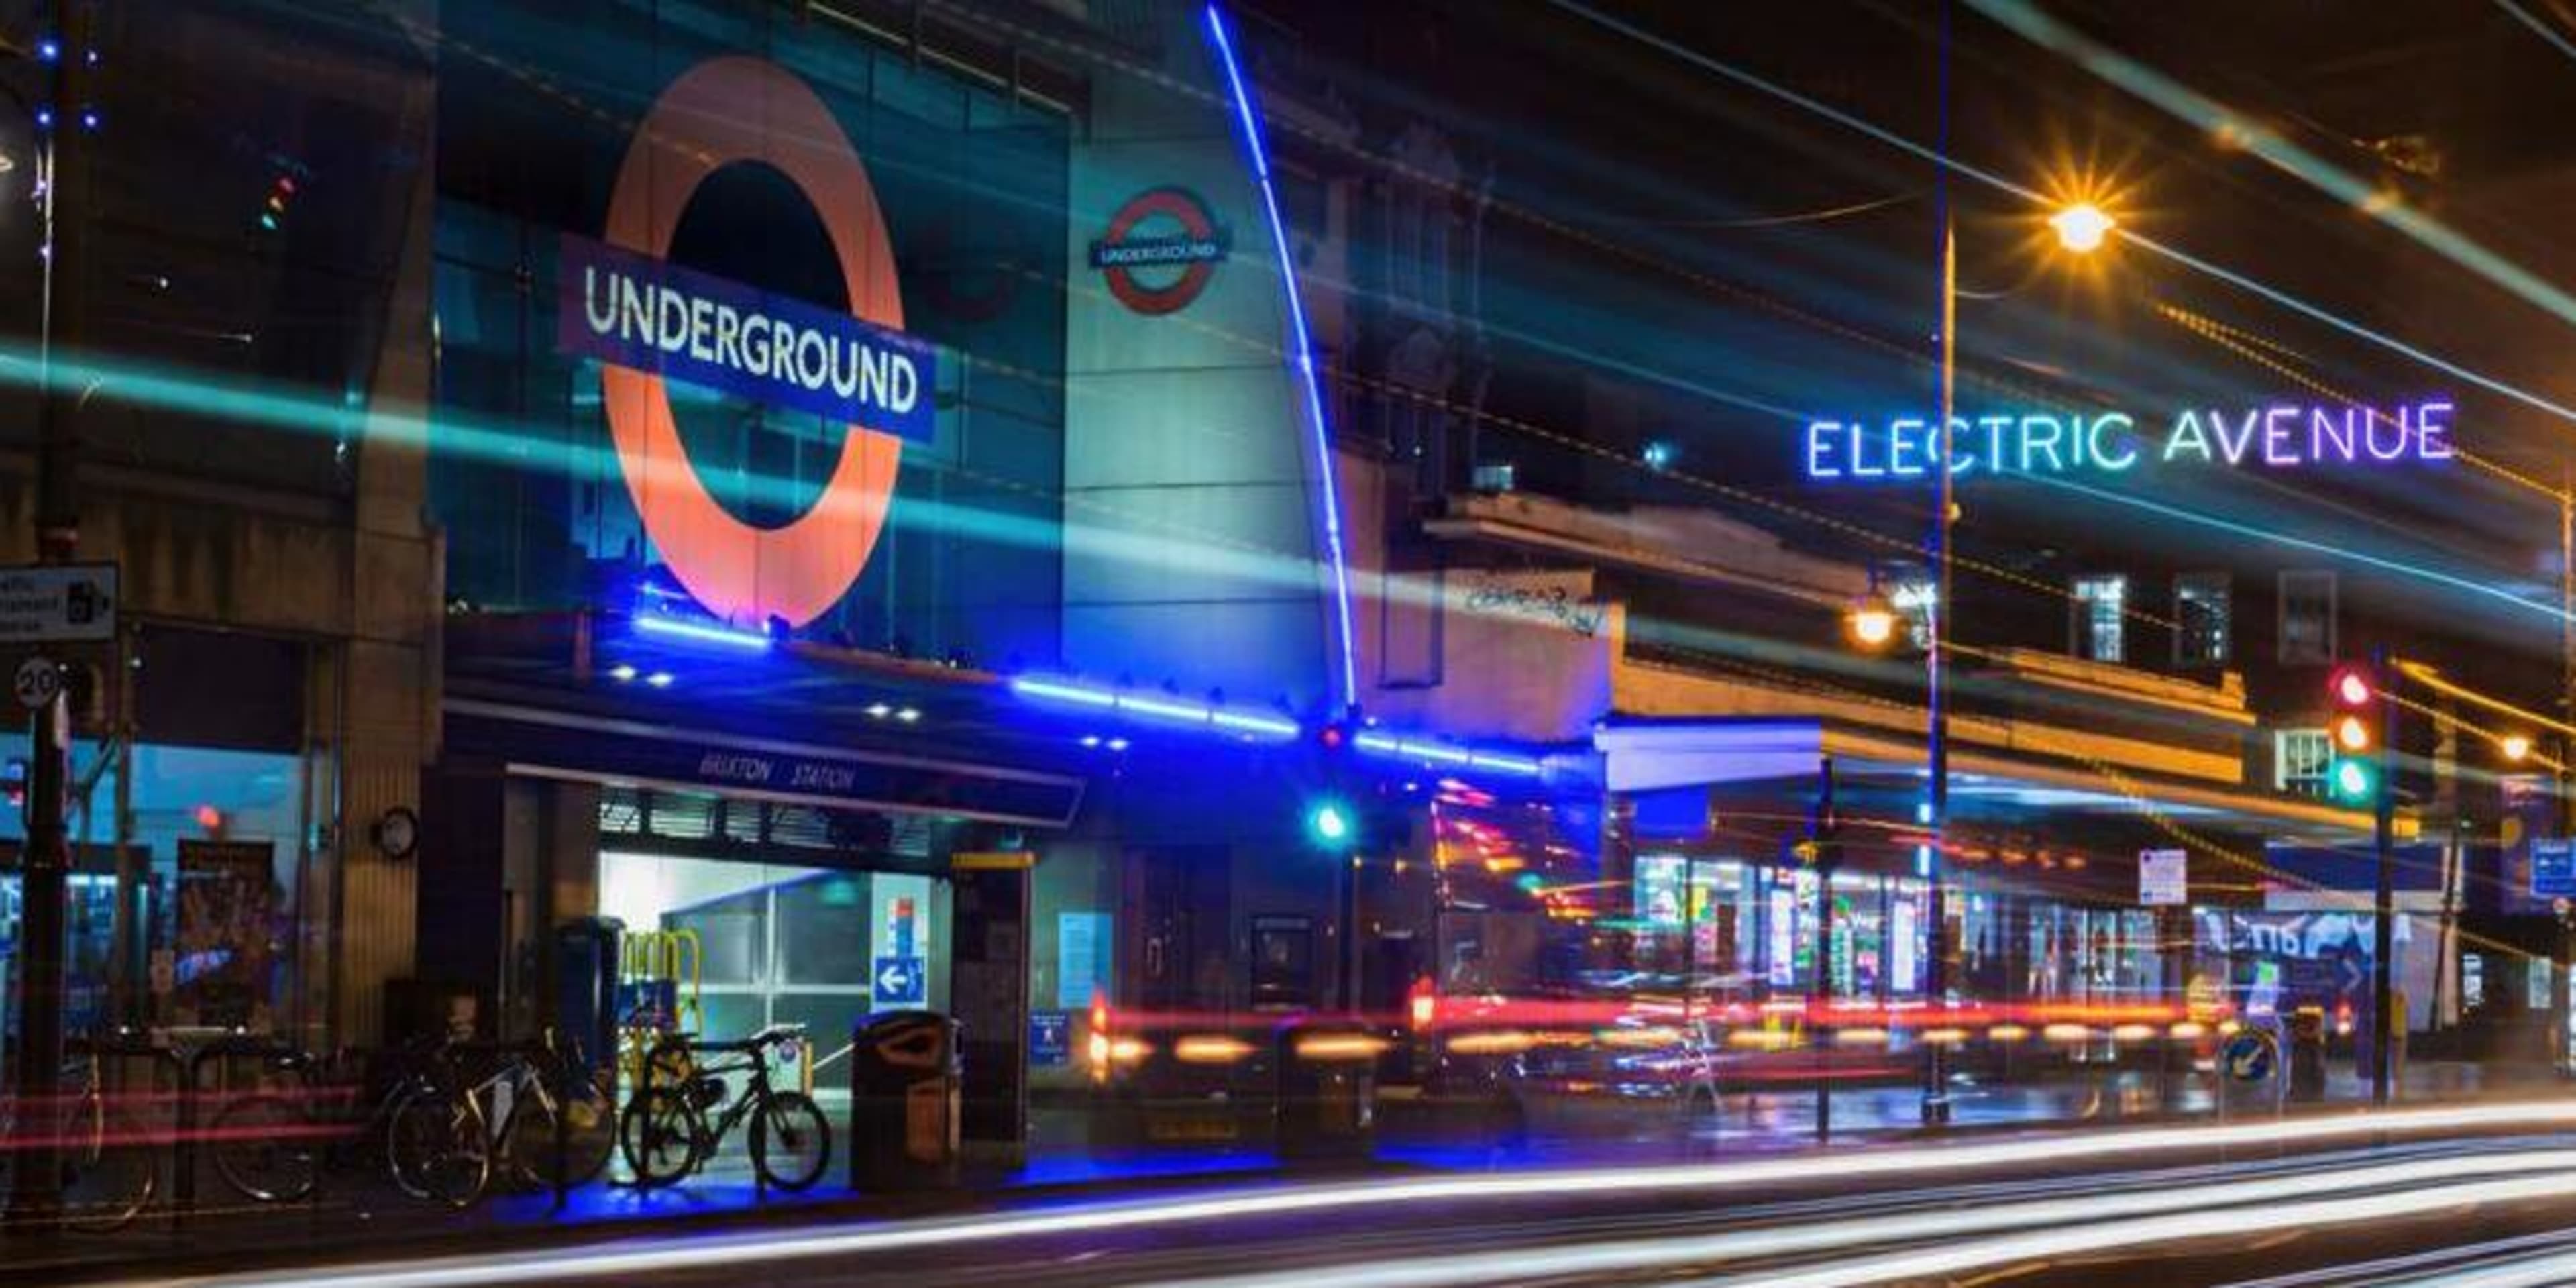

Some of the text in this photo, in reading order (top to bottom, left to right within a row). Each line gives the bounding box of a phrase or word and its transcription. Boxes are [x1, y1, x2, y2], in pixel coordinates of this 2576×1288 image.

[1100, 242, 1216, 264] UNDERGROUND
[585, 266, 917, 414] UNDERGROUND
[1809, 402, 2454, 476] ELECTRIC AVENUE
[18, 668, 56, 696] 20
[790, 763, 856, 790] STATION
